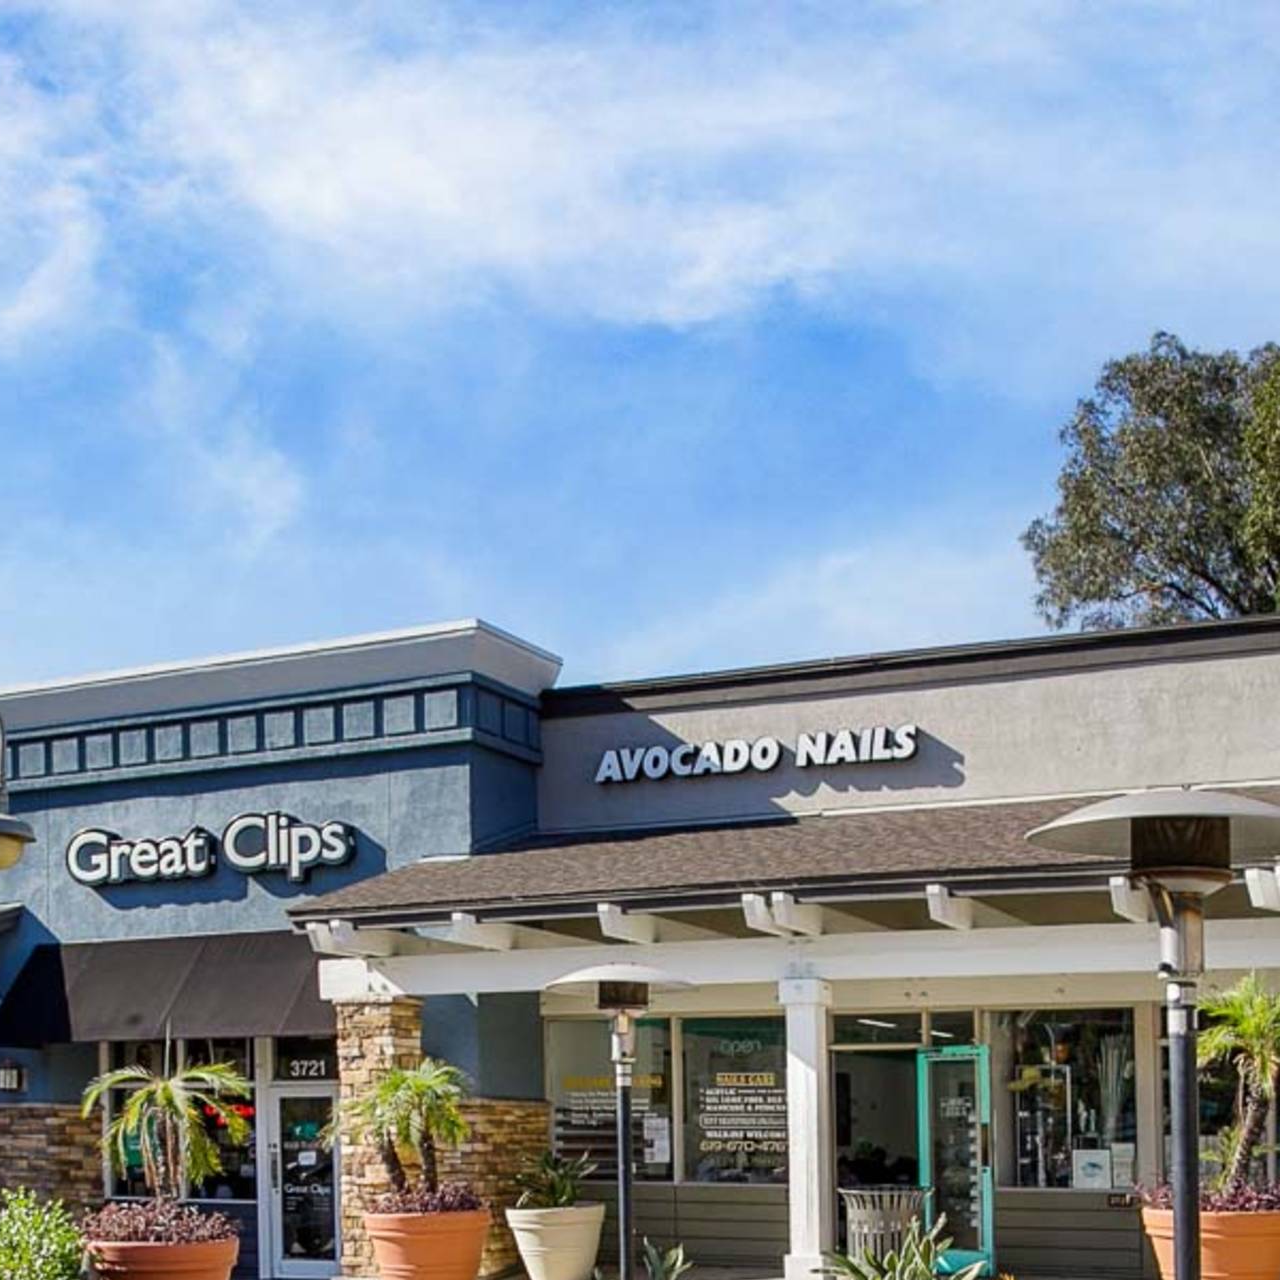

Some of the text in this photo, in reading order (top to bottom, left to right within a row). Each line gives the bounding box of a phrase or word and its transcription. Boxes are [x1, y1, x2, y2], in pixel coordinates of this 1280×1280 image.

[594, 724, 918, 783] AVOCADO NAILS
[67, 811, 348, 884] Great Clips
[289, 1059, 327, 1077] 3721
